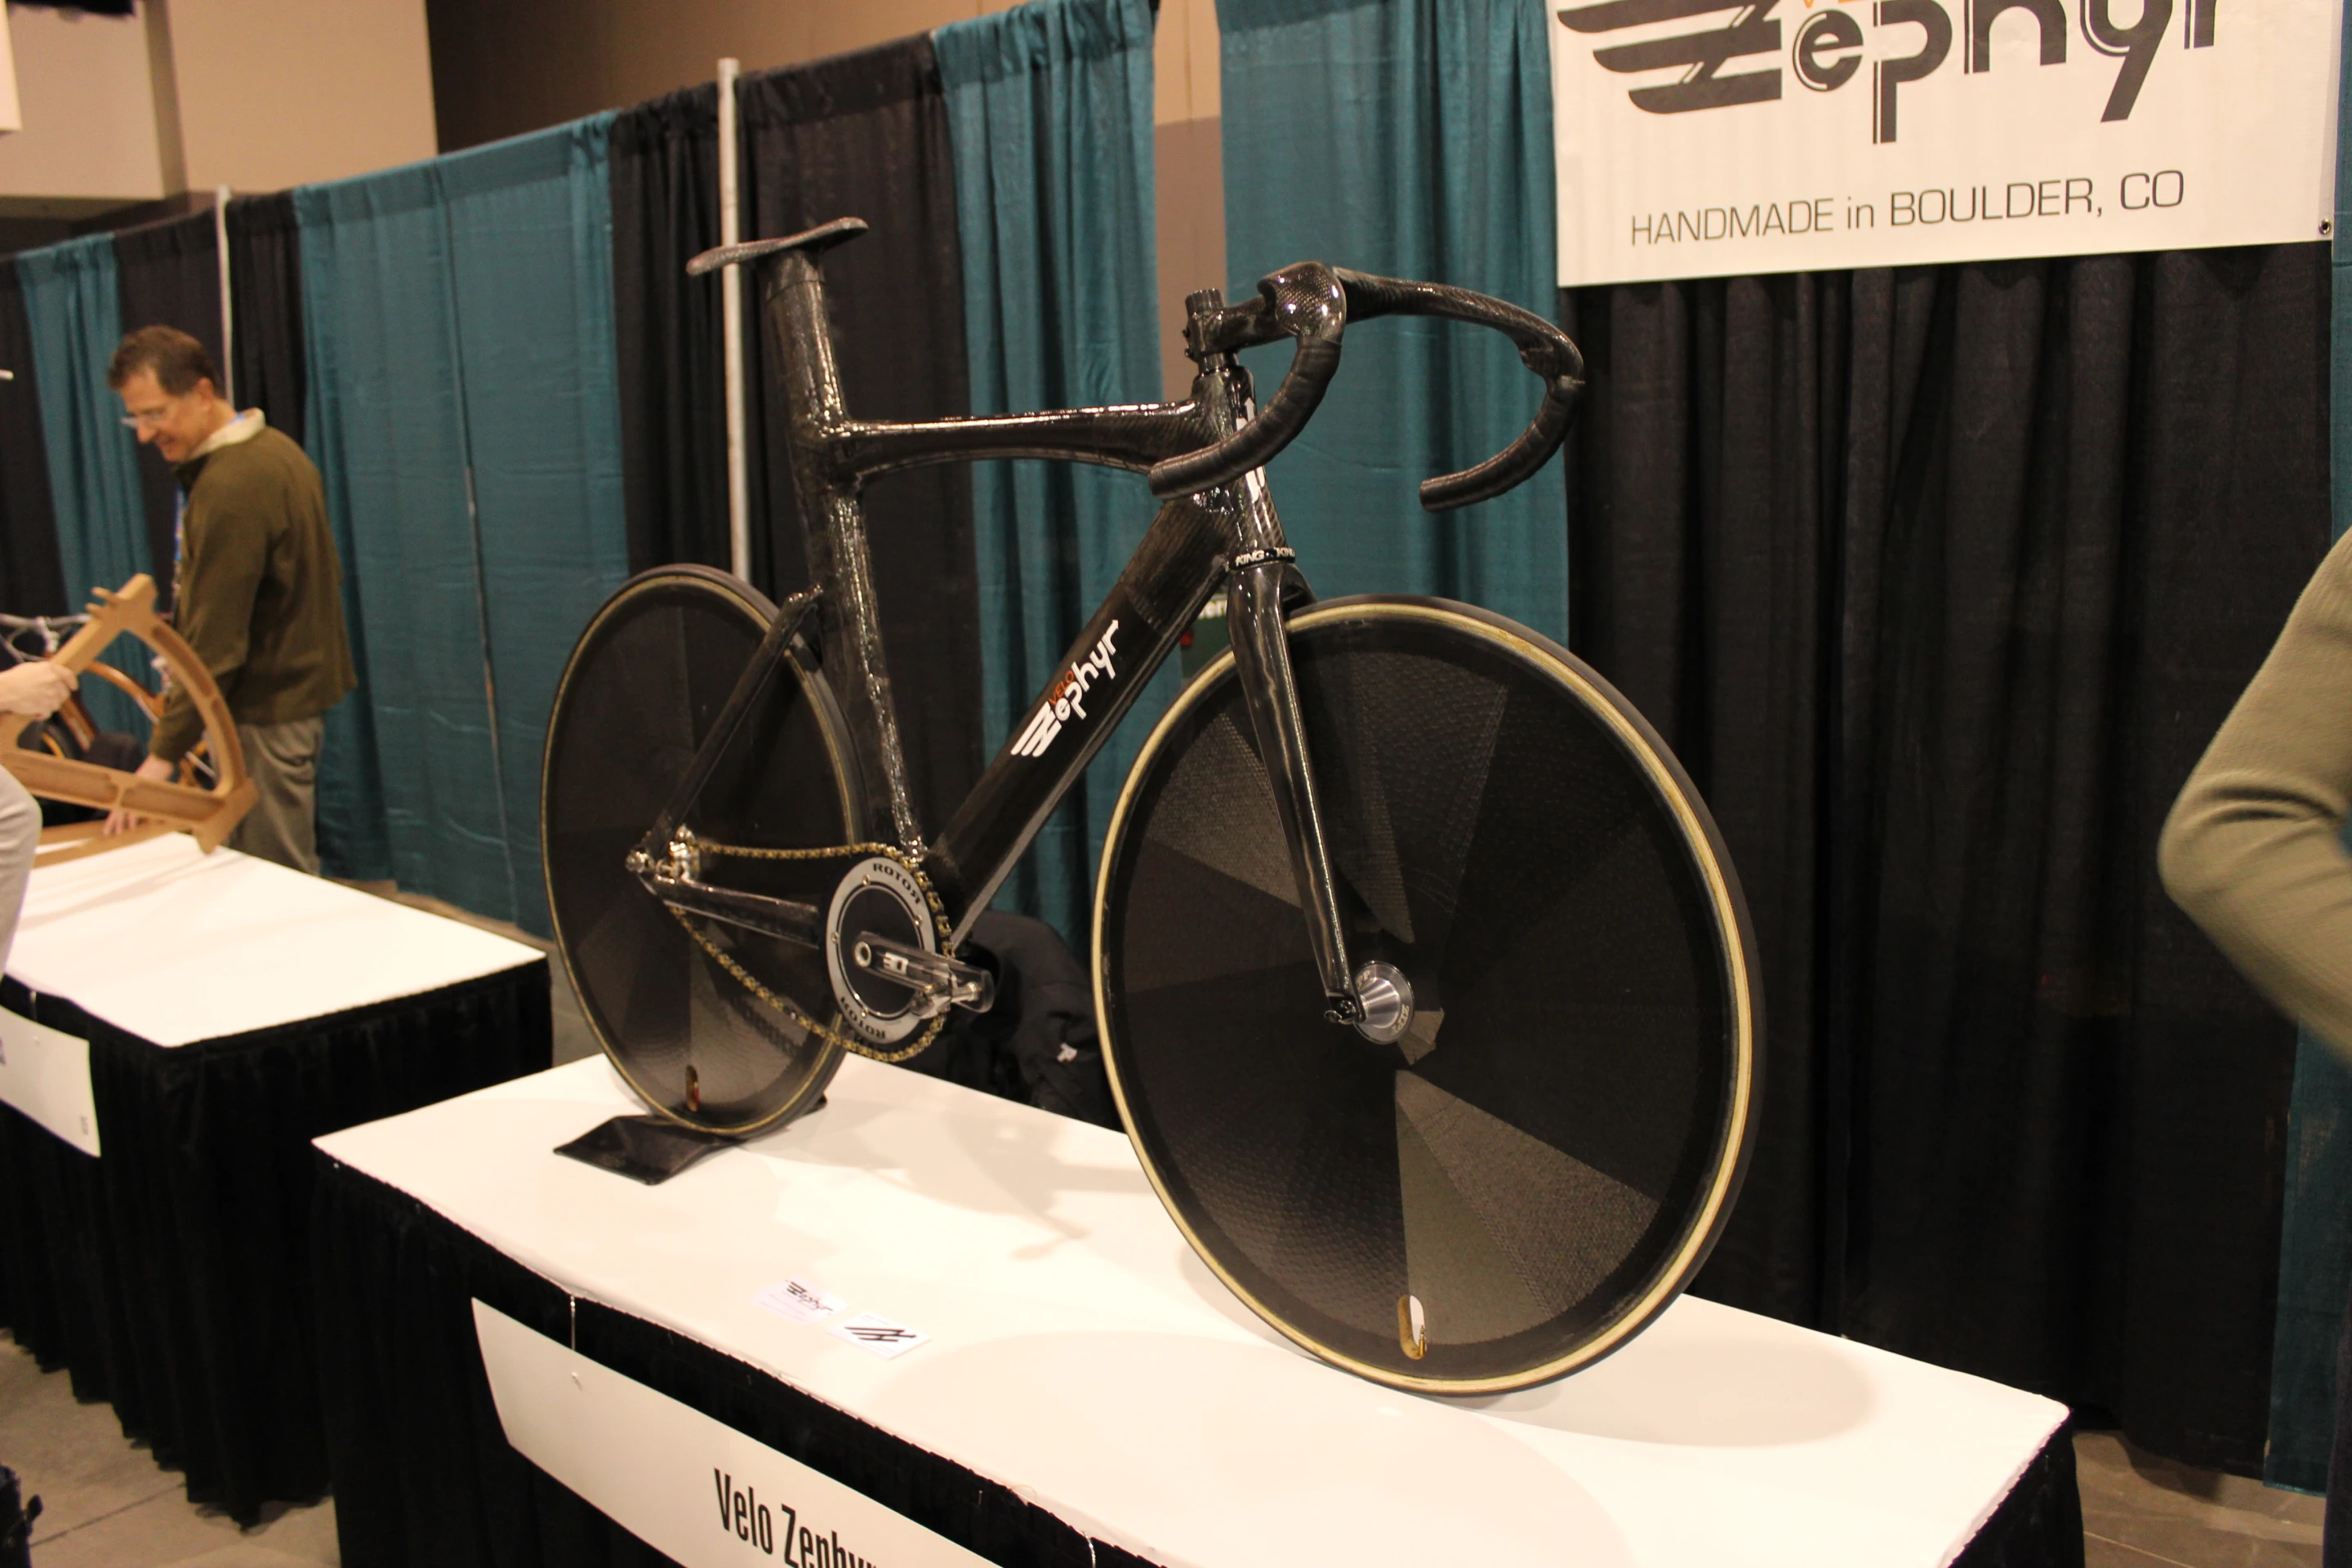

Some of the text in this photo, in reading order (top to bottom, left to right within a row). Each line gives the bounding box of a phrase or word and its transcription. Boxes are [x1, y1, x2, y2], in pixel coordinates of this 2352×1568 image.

[1631, 168, 2185, 247] HANDMADE in BOULDER, CO
[1235, 549, 1265, 567] KING
[1010, 619, 1120, 758] Zephyr
[1048, 670, 1075, 705] VELO
[872, 862, 921, 904] ROTOR
[714, 1468, 876, 1568] Velo Zeph
